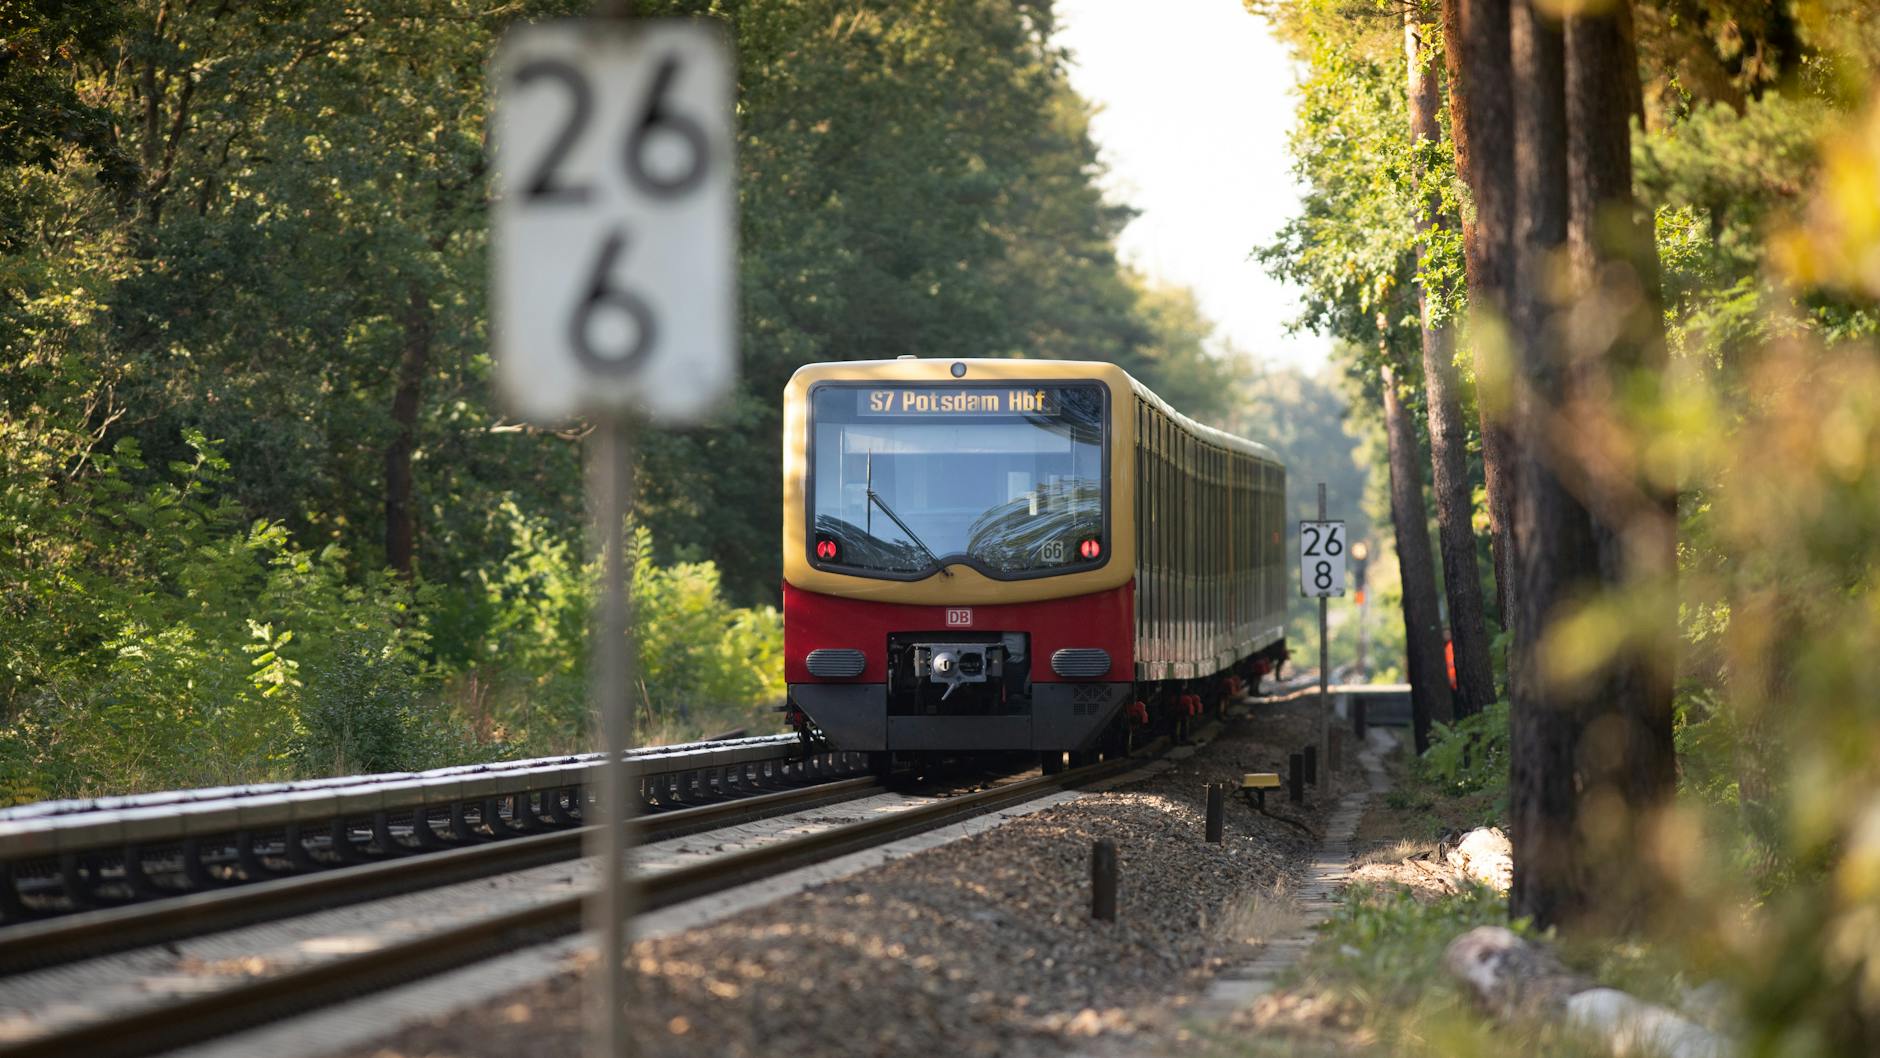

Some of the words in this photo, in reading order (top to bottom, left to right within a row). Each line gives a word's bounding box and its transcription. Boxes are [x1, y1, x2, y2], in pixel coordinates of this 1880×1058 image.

[514, 52, 712, 208] 26
[565, 225, 660, 380] 6
[870, 391, 895, 412] S7
[903, 391, 999, 412] Potsdam
[1009, 391, 1045, 412] Hbf
[1043, 542, 1062, 559] 66
[1303, 527, 1343, 556] 26
[1314, 561, 1333, 589] 8
[949, 611, 970, 624] DB
